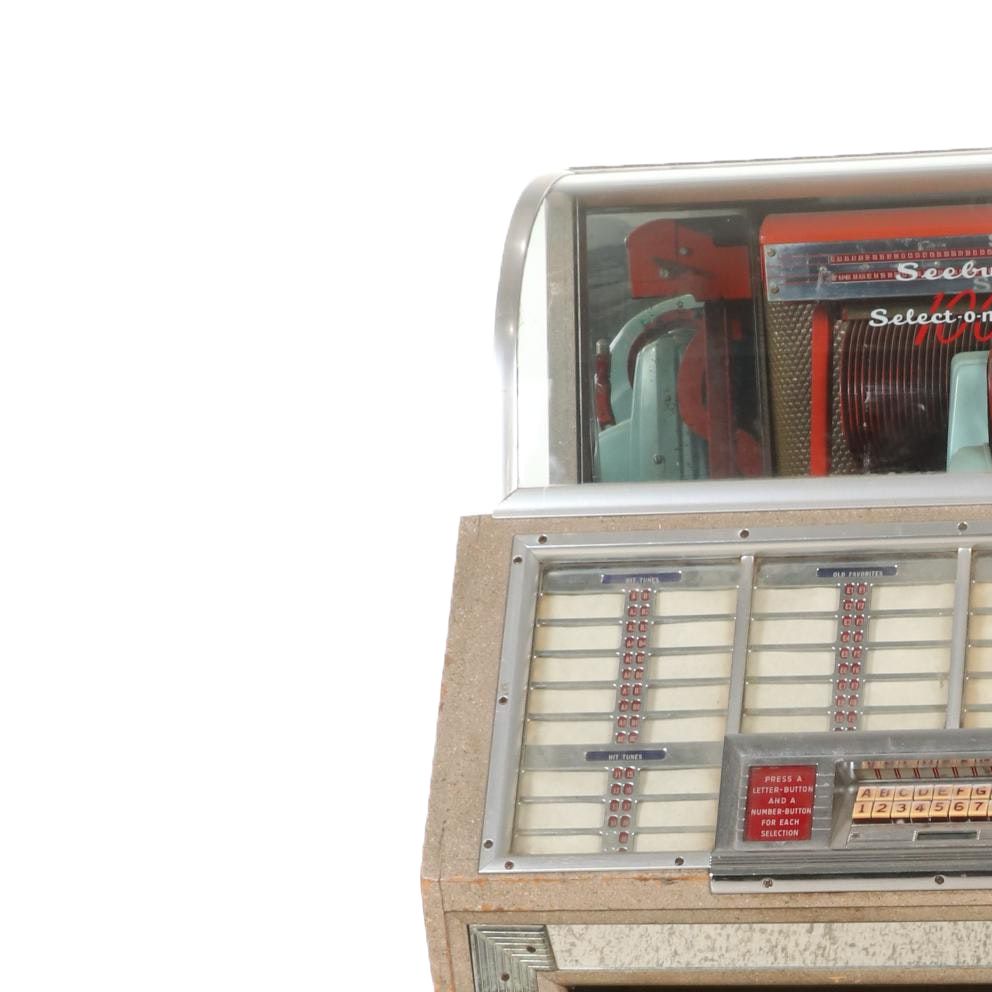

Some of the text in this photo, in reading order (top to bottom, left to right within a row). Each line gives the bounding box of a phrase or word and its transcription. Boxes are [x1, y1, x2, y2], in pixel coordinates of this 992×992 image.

[764, 775, 793, 783] PRESS
[752, 785, 814, 794] LETTER-BUTTON
[750, 807, 812, 816] NUMBER-BUTTON
[858, 803, 865, 813] 1
[876, 803, 888, 813] 2
[896, 803, 906, 813] 3
[915, 803, 924, 812] 4
[934, 802, 944, 812] 5
[953, 801, 964, 811] 6
[974, 801, 984, 811] 7
[761, 818, 800, 827] FOR EACH
[760, 829, 799, 837] SELECTION
